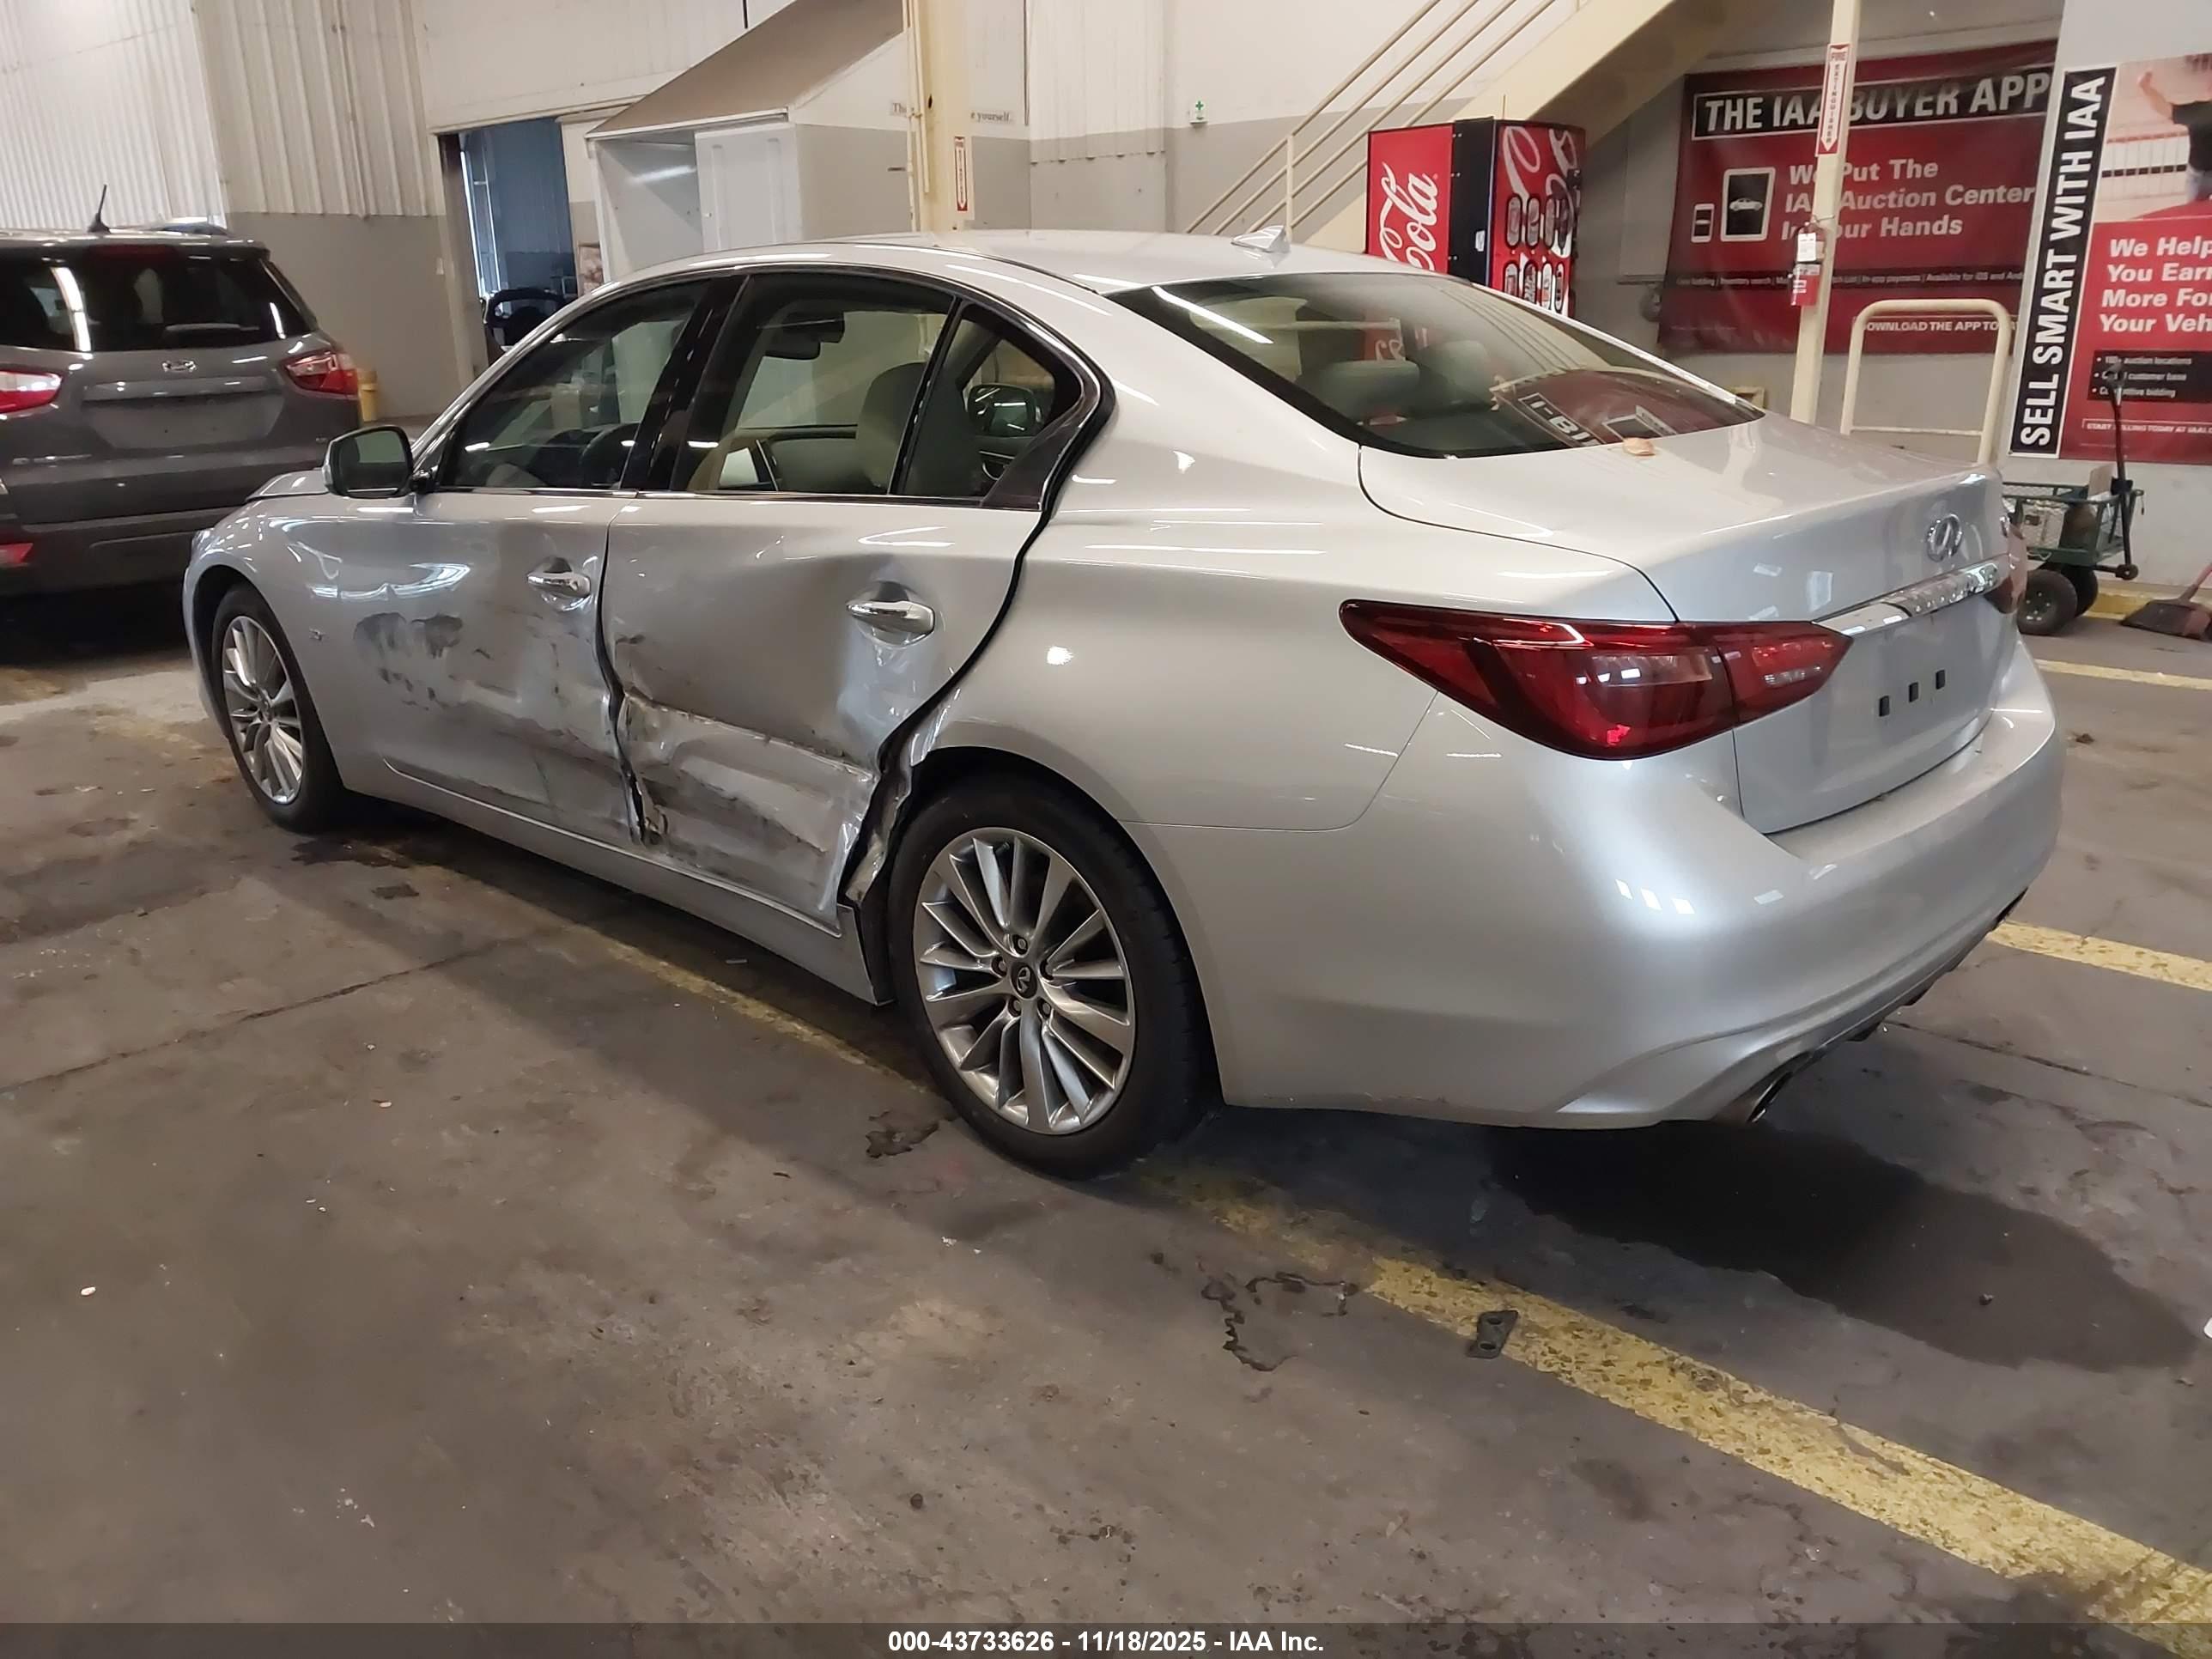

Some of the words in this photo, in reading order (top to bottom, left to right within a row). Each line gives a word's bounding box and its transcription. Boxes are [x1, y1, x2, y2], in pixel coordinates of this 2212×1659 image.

[1705, 97, 1763, 132] THE
[1772, 94, 1821, 127] IAA
[1848, 82, 1960, 122] BUYER
[1970, 72, 2051, 113] APP
[2063, 76, 2106, 140] IAA
[1790, 163, 1817, 185] W
[1841, 162, 1880, 182] Put
[1888, 159, 1939, 179] The
[1785, 192, 1812, 213] IA
[1839, 188, 1936, 210] Auction
[1945, 184, 2036, 206] Center
[2050, 150, 2094, 241] WITH
[1836, 223, 1872, 240] our
[1880, 215, 1964, 238] Hands
[2109, 238, 2148, 258] We
[2156, 235, 2212, 259] Help
[2107, 264, 2153, 283] You
[2032, 249, 2077, 365] SMART
[2101, 289, 2168, 307] More
[2176, 288, 2212, 307] Fo
[1865, 320, 1928, 331] OWNLOAD
[1929, 320, 1953, 331] THE
[1954, 320, 1981, 331] APP
[2099, 313, 2157, 332] Your
[2020, 374, 2059, 446] SELL
